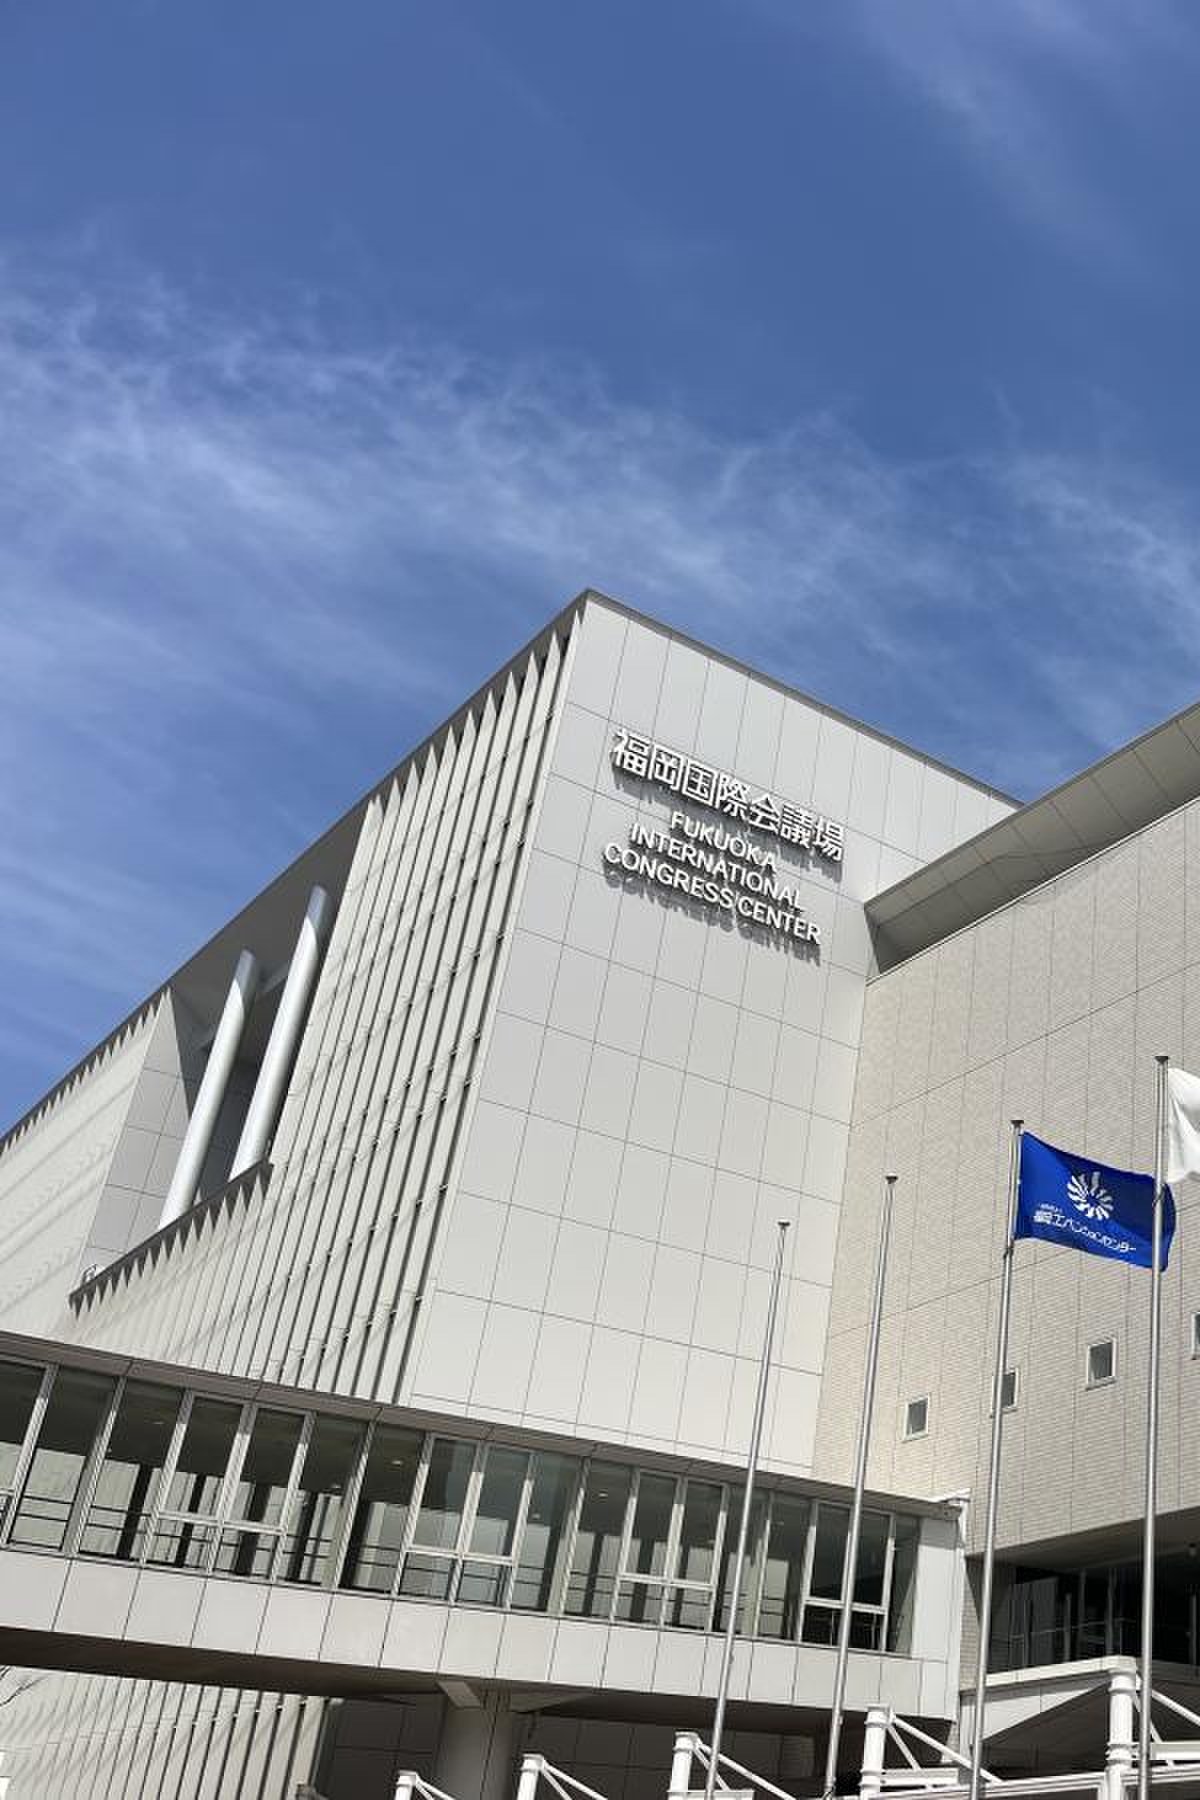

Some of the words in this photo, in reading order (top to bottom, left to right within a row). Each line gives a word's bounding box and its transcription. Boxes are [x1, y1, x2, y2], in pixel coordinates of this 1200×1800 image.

[613, 728, 844, 862] 福岡国際会議場
[670, 810, 776, 872] FUKUOKA
[603, 842, 736, 910] CONGRESS
[737, 895, 822, 945] CENTER
[630, 822, 806, 910] INTERNATIONAL
